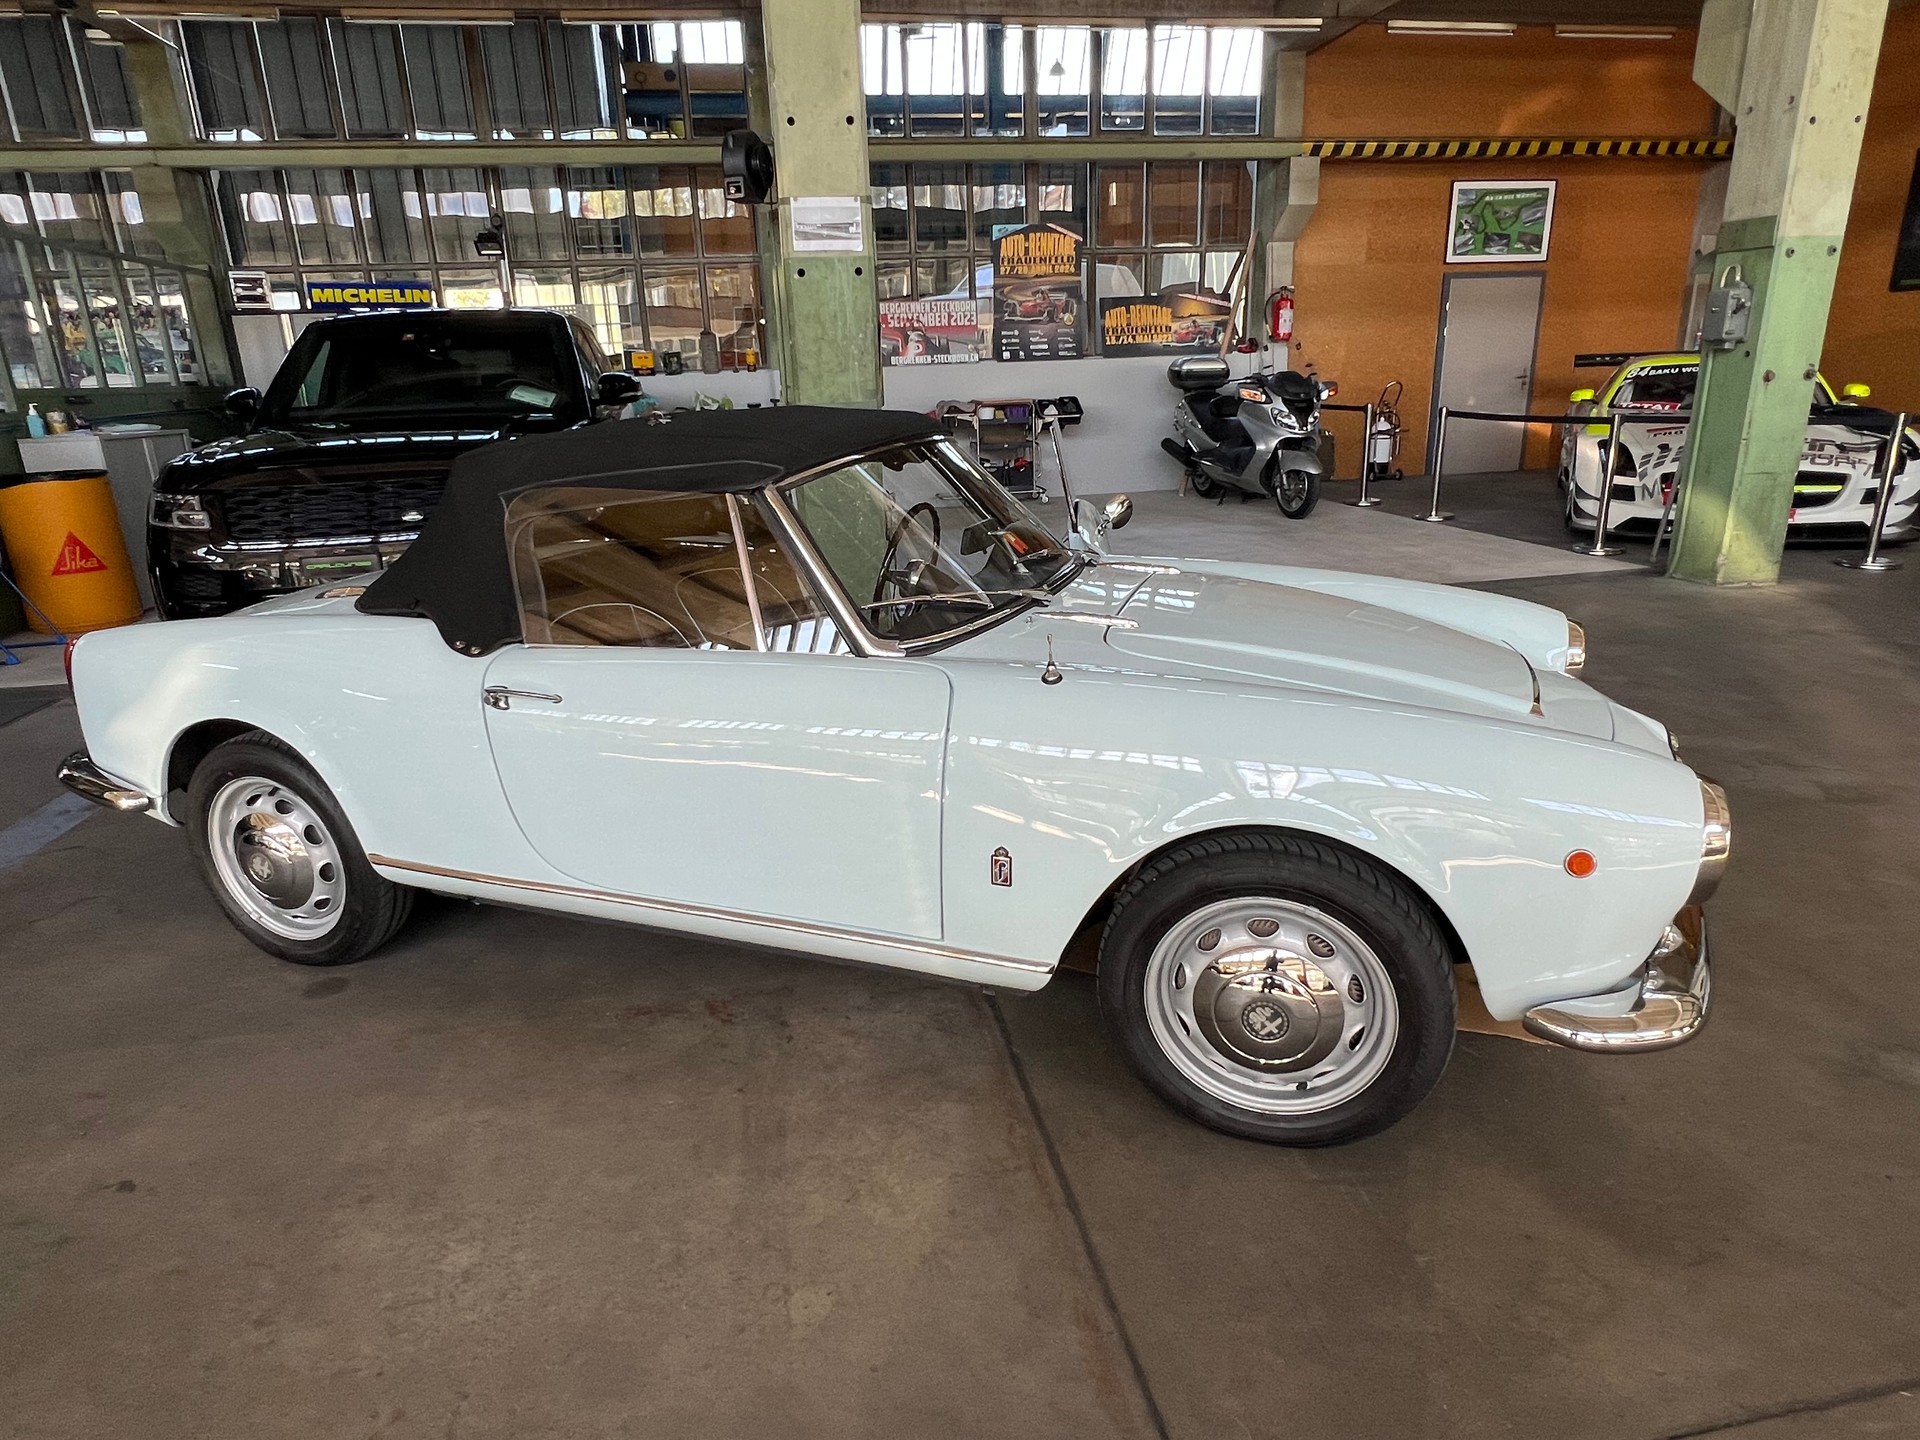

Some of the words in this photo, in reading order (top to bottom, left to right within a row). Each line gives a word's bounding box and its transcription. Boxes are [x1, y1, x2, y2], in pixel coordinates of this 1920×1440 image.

[1000, 255, 1076, 265] FRAUENFELD
[311, 288, 430, 303] MICHELIN
[879, 301, 930, 314] BERGRENNEN
[931, 300, 976, 311] STECKBORN
[887, 313, 949, 328] SEPTEMBER
[950, 311, 976, 326] 2023
[1105, 325, 1172, 336] FRAUENFELD
[1648, 367, 1679, 376] BAKU
[59, 546, 99, 571] Sika
